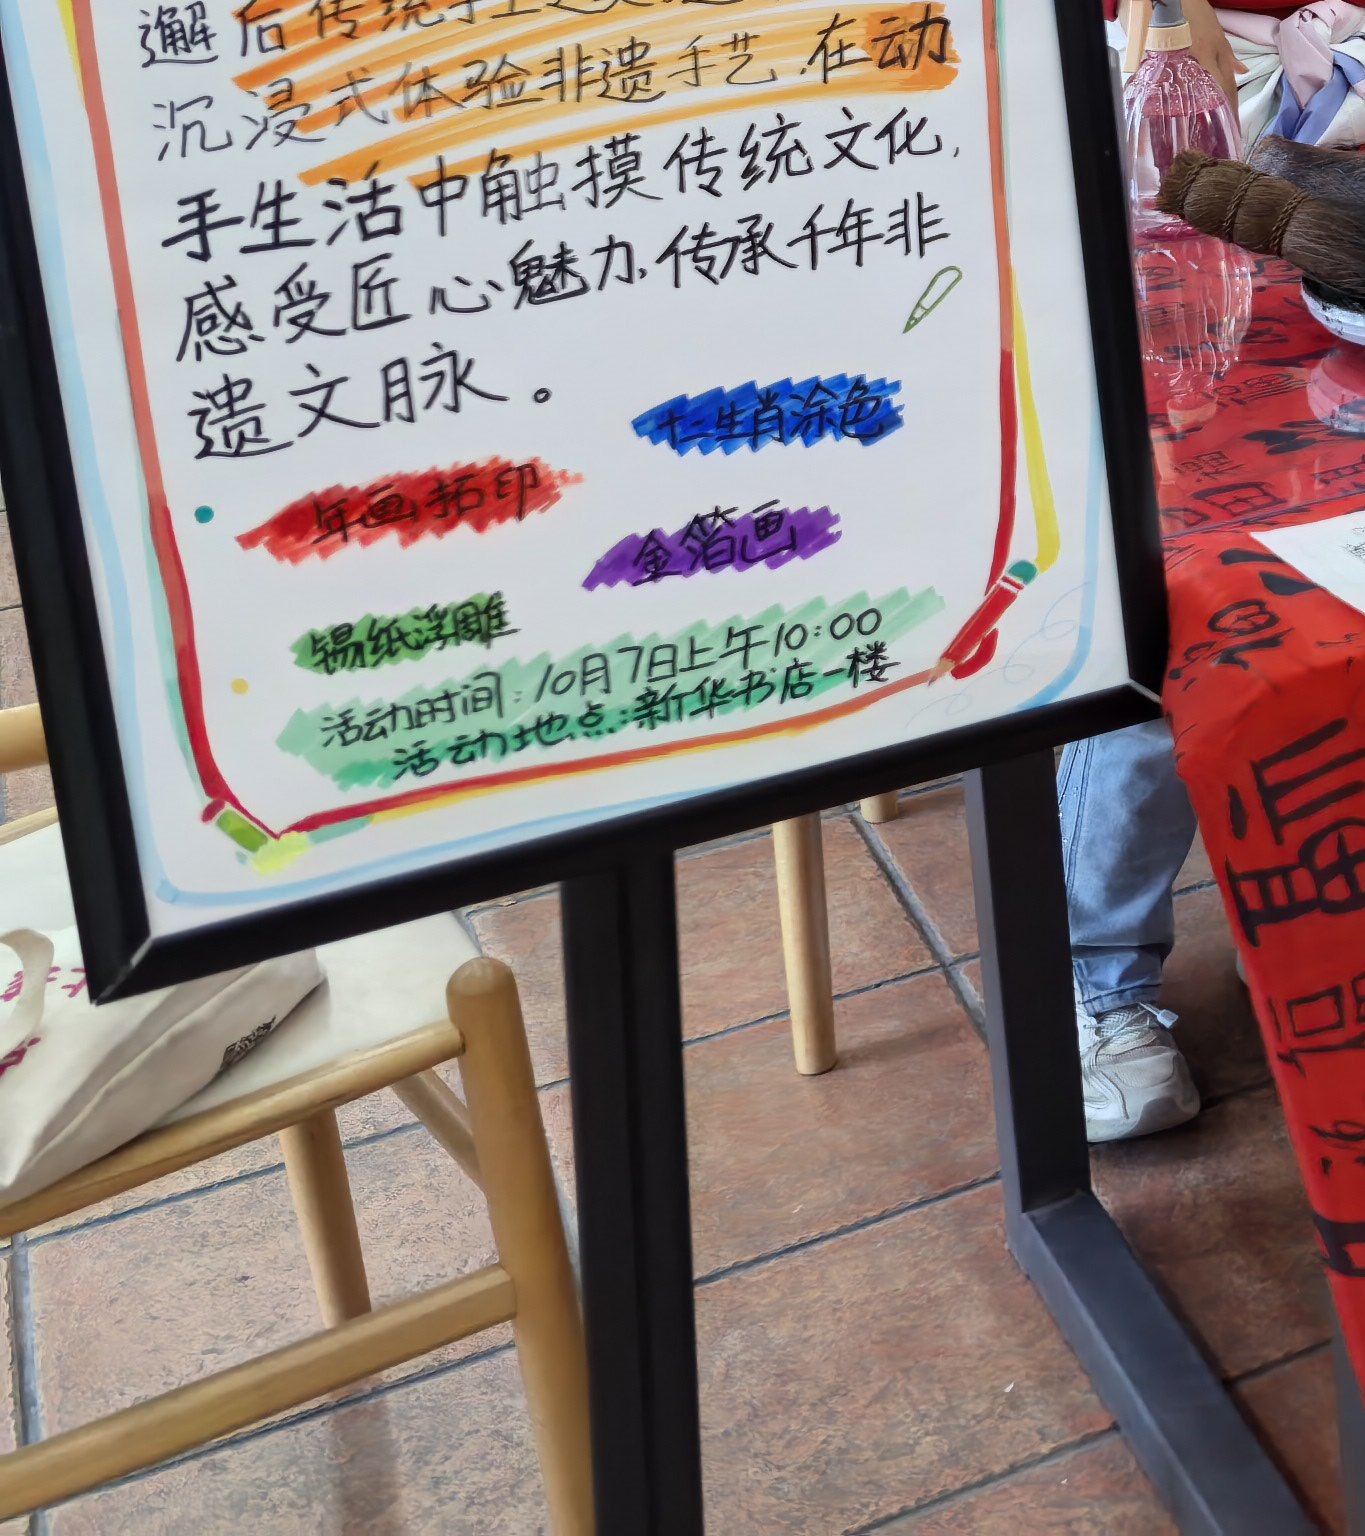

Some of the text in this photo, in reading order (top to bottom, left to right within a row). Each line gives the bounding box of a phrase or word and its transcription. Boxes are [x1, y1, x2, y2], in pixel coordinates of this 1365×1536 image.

[657, 378, 886, 451] 十二生肖涂色
[312, 464, 543, 546] 年画拓印
[633, 501, 799, 587] 金箔画
[309, 591, 521, 676] 锡纸浮雕
